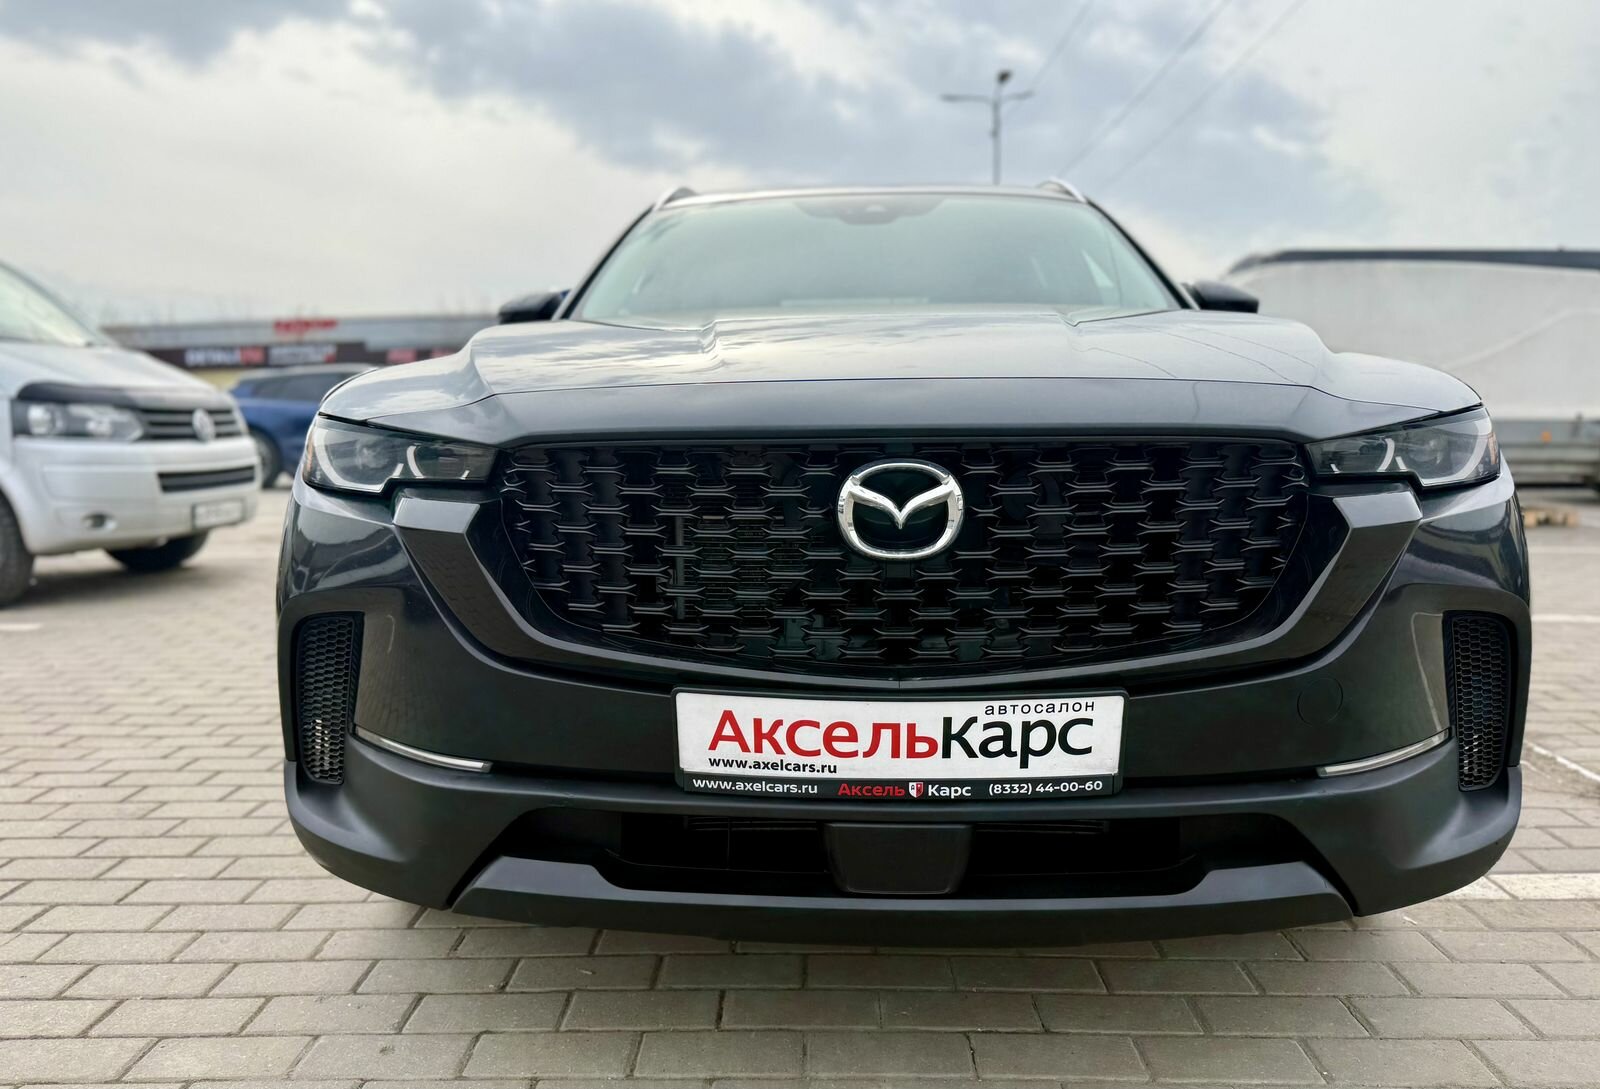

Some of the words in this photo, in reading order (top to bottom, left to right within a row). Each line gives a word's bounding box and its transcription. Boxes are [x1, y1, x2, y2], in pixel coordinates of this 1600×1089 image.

[984, 701, 1095, 716] автосалон
[708, 709, 1094, 769] АксельКарс
[708, 757, 838, 774] www.axelcars.ru
[692, 778, 818, 794] www.axelcars.ru
[837, 783, 905, 797] Аксель
[928, 784, 972, 799] Карс
[988, 782, 1033, 796] (8332)
[1035, 780, 1103, 793] 44-00-60
